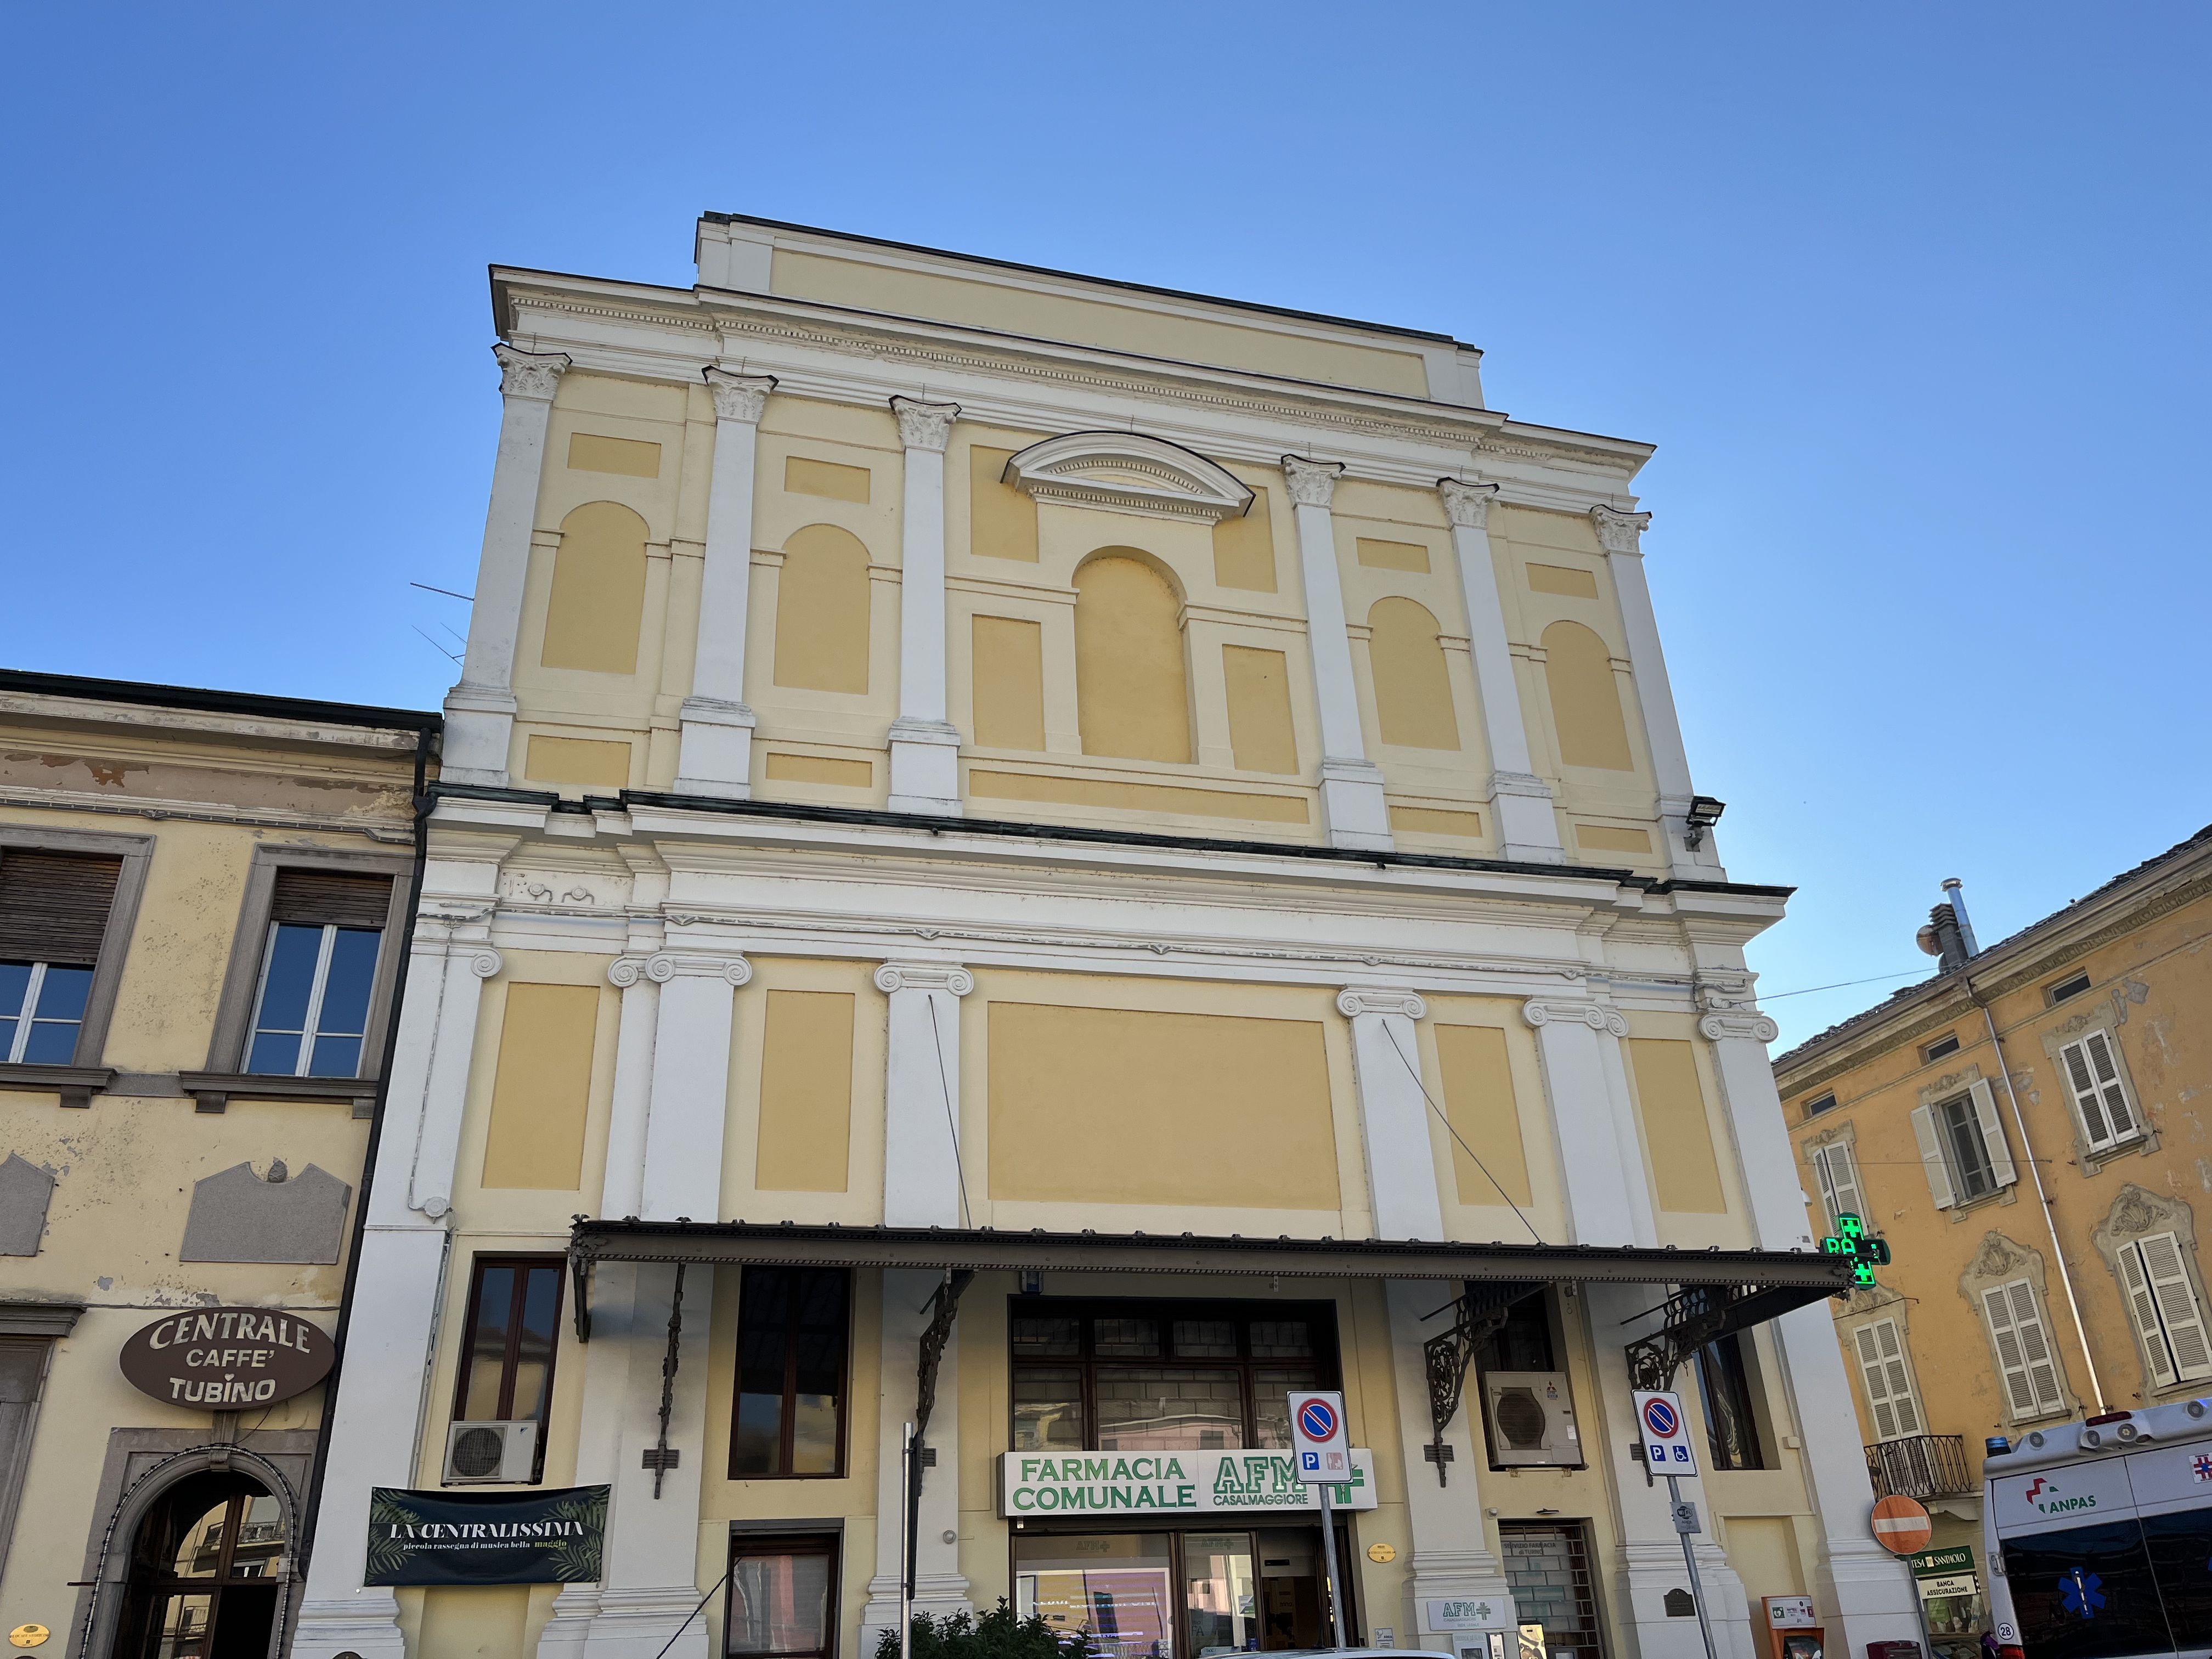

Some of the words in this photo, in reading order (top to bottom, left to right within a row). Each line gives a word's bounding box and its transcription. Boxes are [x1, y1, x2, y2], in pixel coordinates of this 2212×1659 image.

[149, 1313, 311, 1354] CENTRALE
[1653, 1447, 1661, 1459] P
[1306, 1454, 1316, 1468] P
[1021, 1458, 1187, 1481] FARMACIA
[1213, 1457, 1307, 1494] AFM
[1013, 1484, 1197, 1510] COMUNALE
[1213, 1494, 1308, 1506] CASALMAGGIORE
[2050, 1495, 2096, 1514] ANPAS
[390, 1524, 414, 1538] LA
[421, 1521, 583, 1538] CENTRALISSIMA
[534, 1539, 567, 1549] maggio
[1934, 1553, 1966, 1566] SANPAOLO
[1927, 1586, 1968, 1596] ASSICURAZIONE
[1443, 1602, 1476, 1617] AFM
[2000, 1627, 2011, 1636] 28
